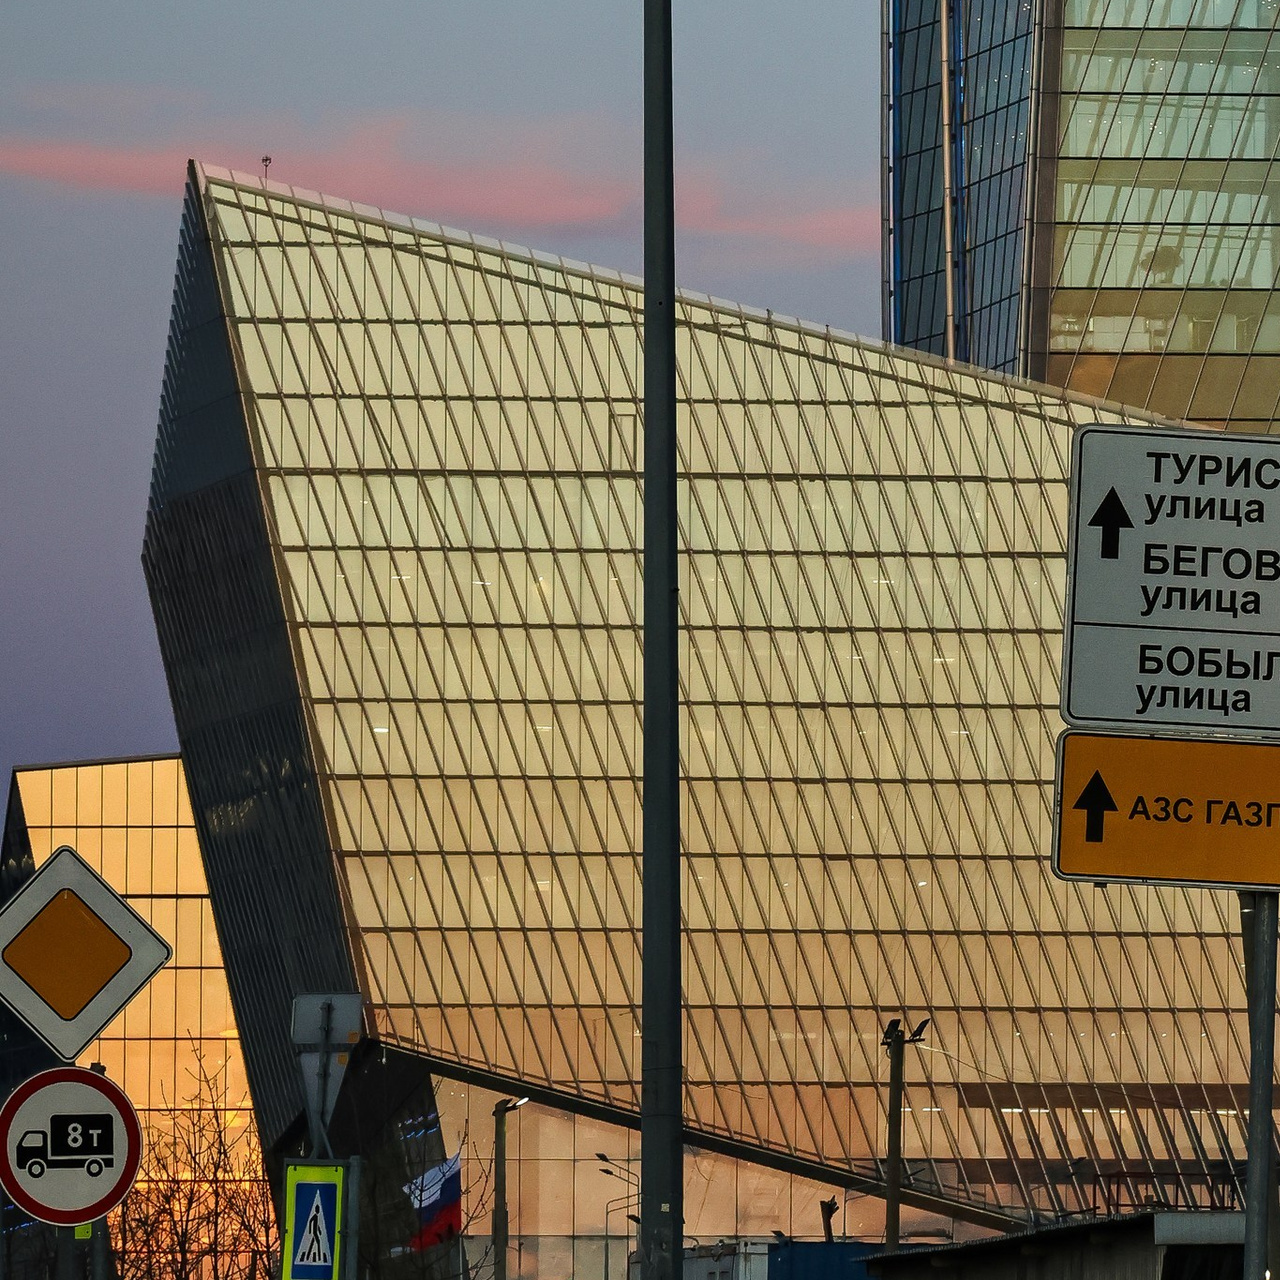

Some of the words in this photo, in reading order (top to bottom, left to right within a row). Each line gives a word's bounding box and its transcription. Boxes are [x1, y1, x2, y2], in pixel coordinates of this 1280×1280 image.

[1144, 492, 1265, 527] улица
[1140, 583, 1262, 617] улица
[1135, 682, 1252, 716] улица
[1127, 795, 1194, 823] АЗС
